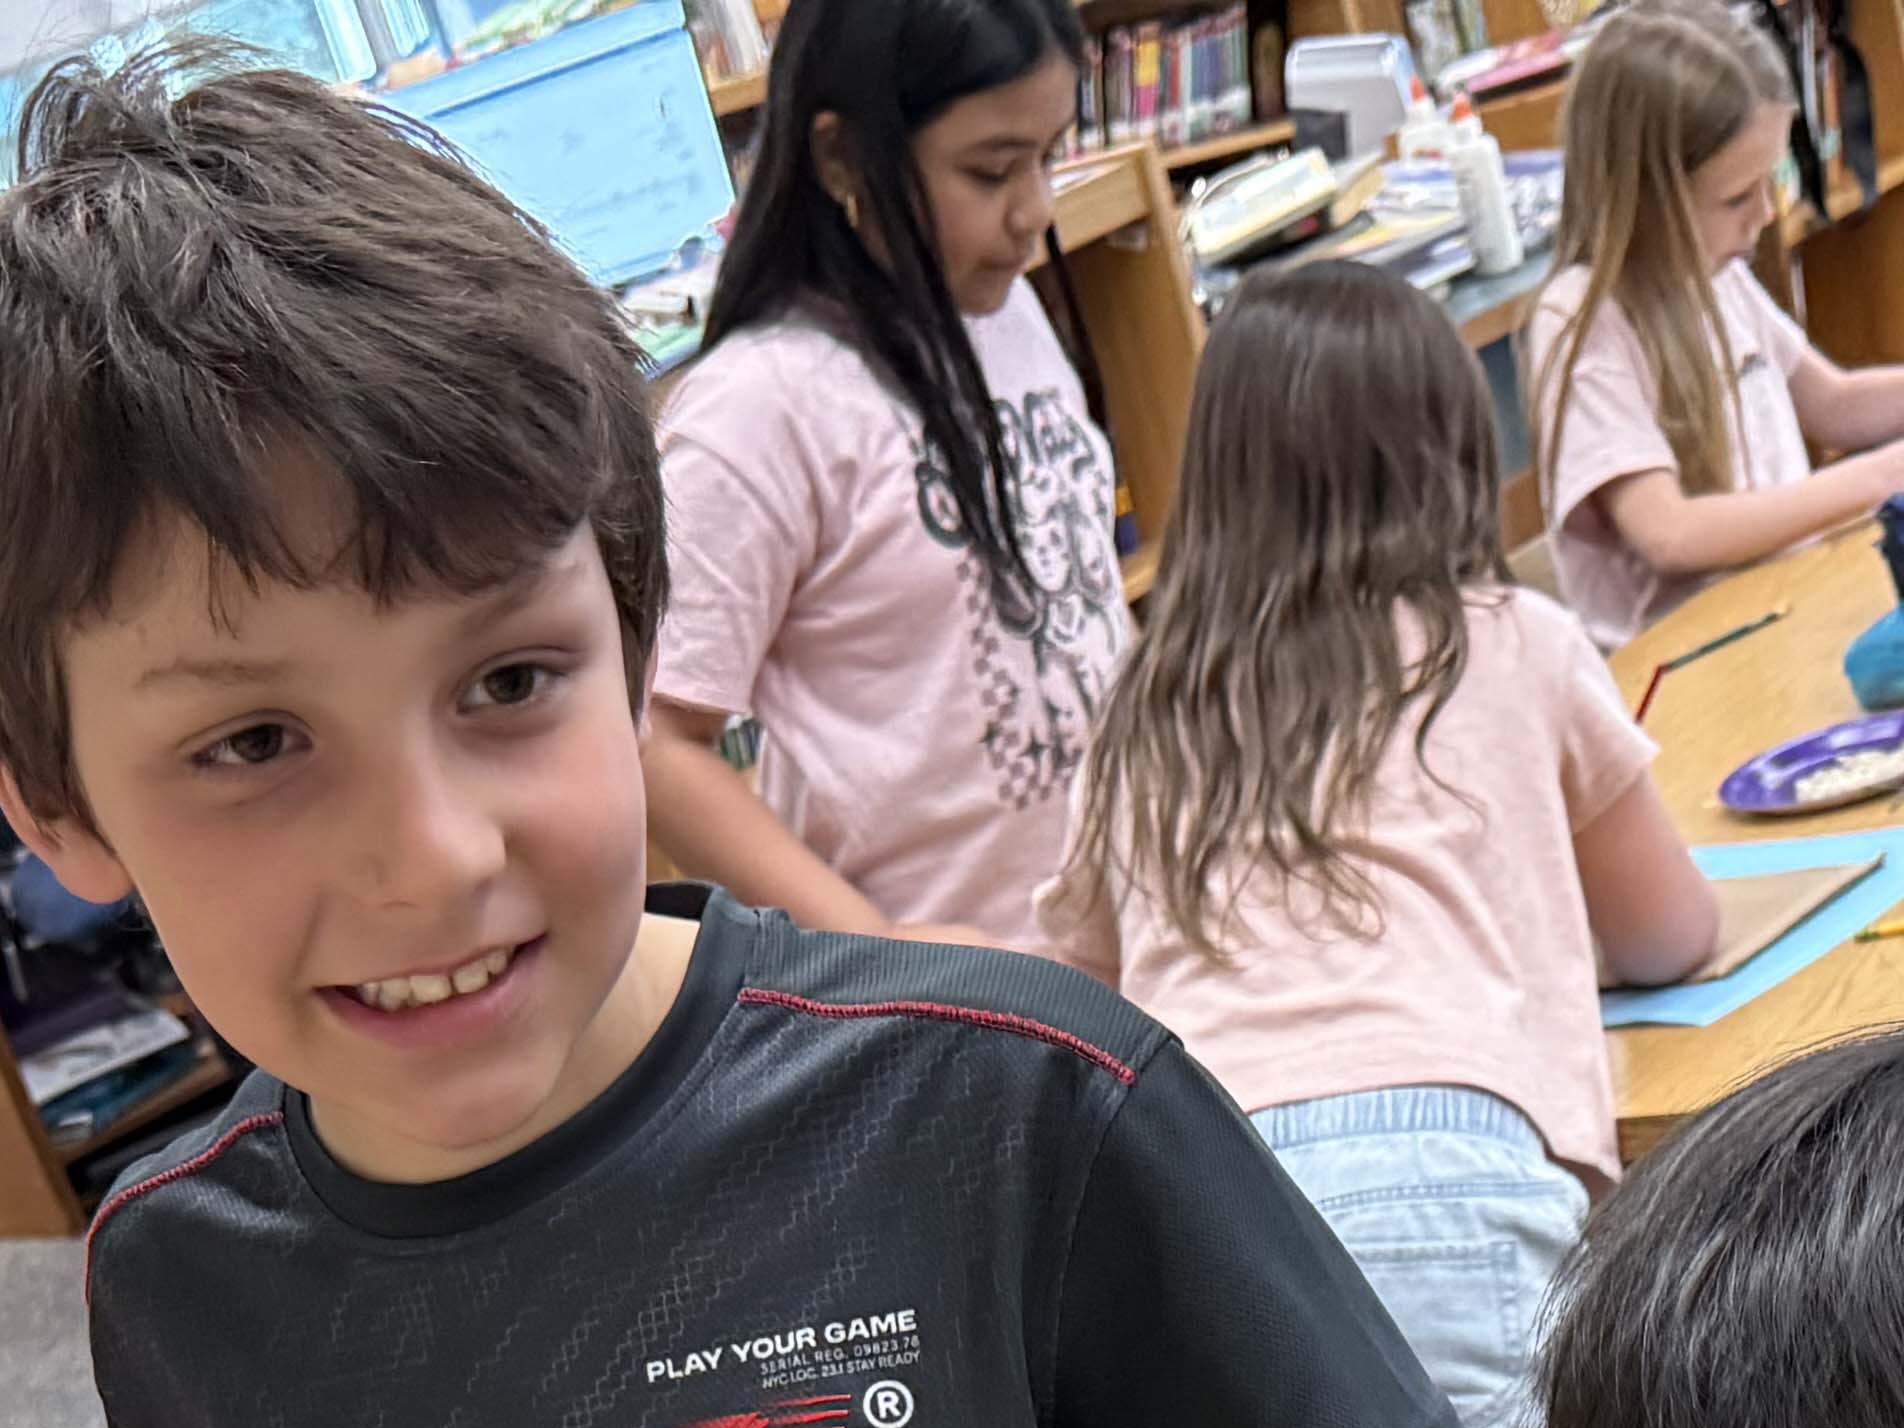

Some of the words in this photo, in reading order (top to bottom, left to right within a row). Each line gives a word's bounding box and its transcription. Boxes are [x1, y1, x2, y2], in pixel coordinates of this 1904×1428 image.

[647, 1347, 723, 1383] PLAY
[731, 1326, 817, 1363] YOUR
[823, 1309, 918, 1344] GAME
[760, 1351, 811, 1376] SERIAL
[762, 1370, 788, 1389] NYC
[846, 1356, 878, 1375] STAY
[878, 1350, 921, 1369] READY
